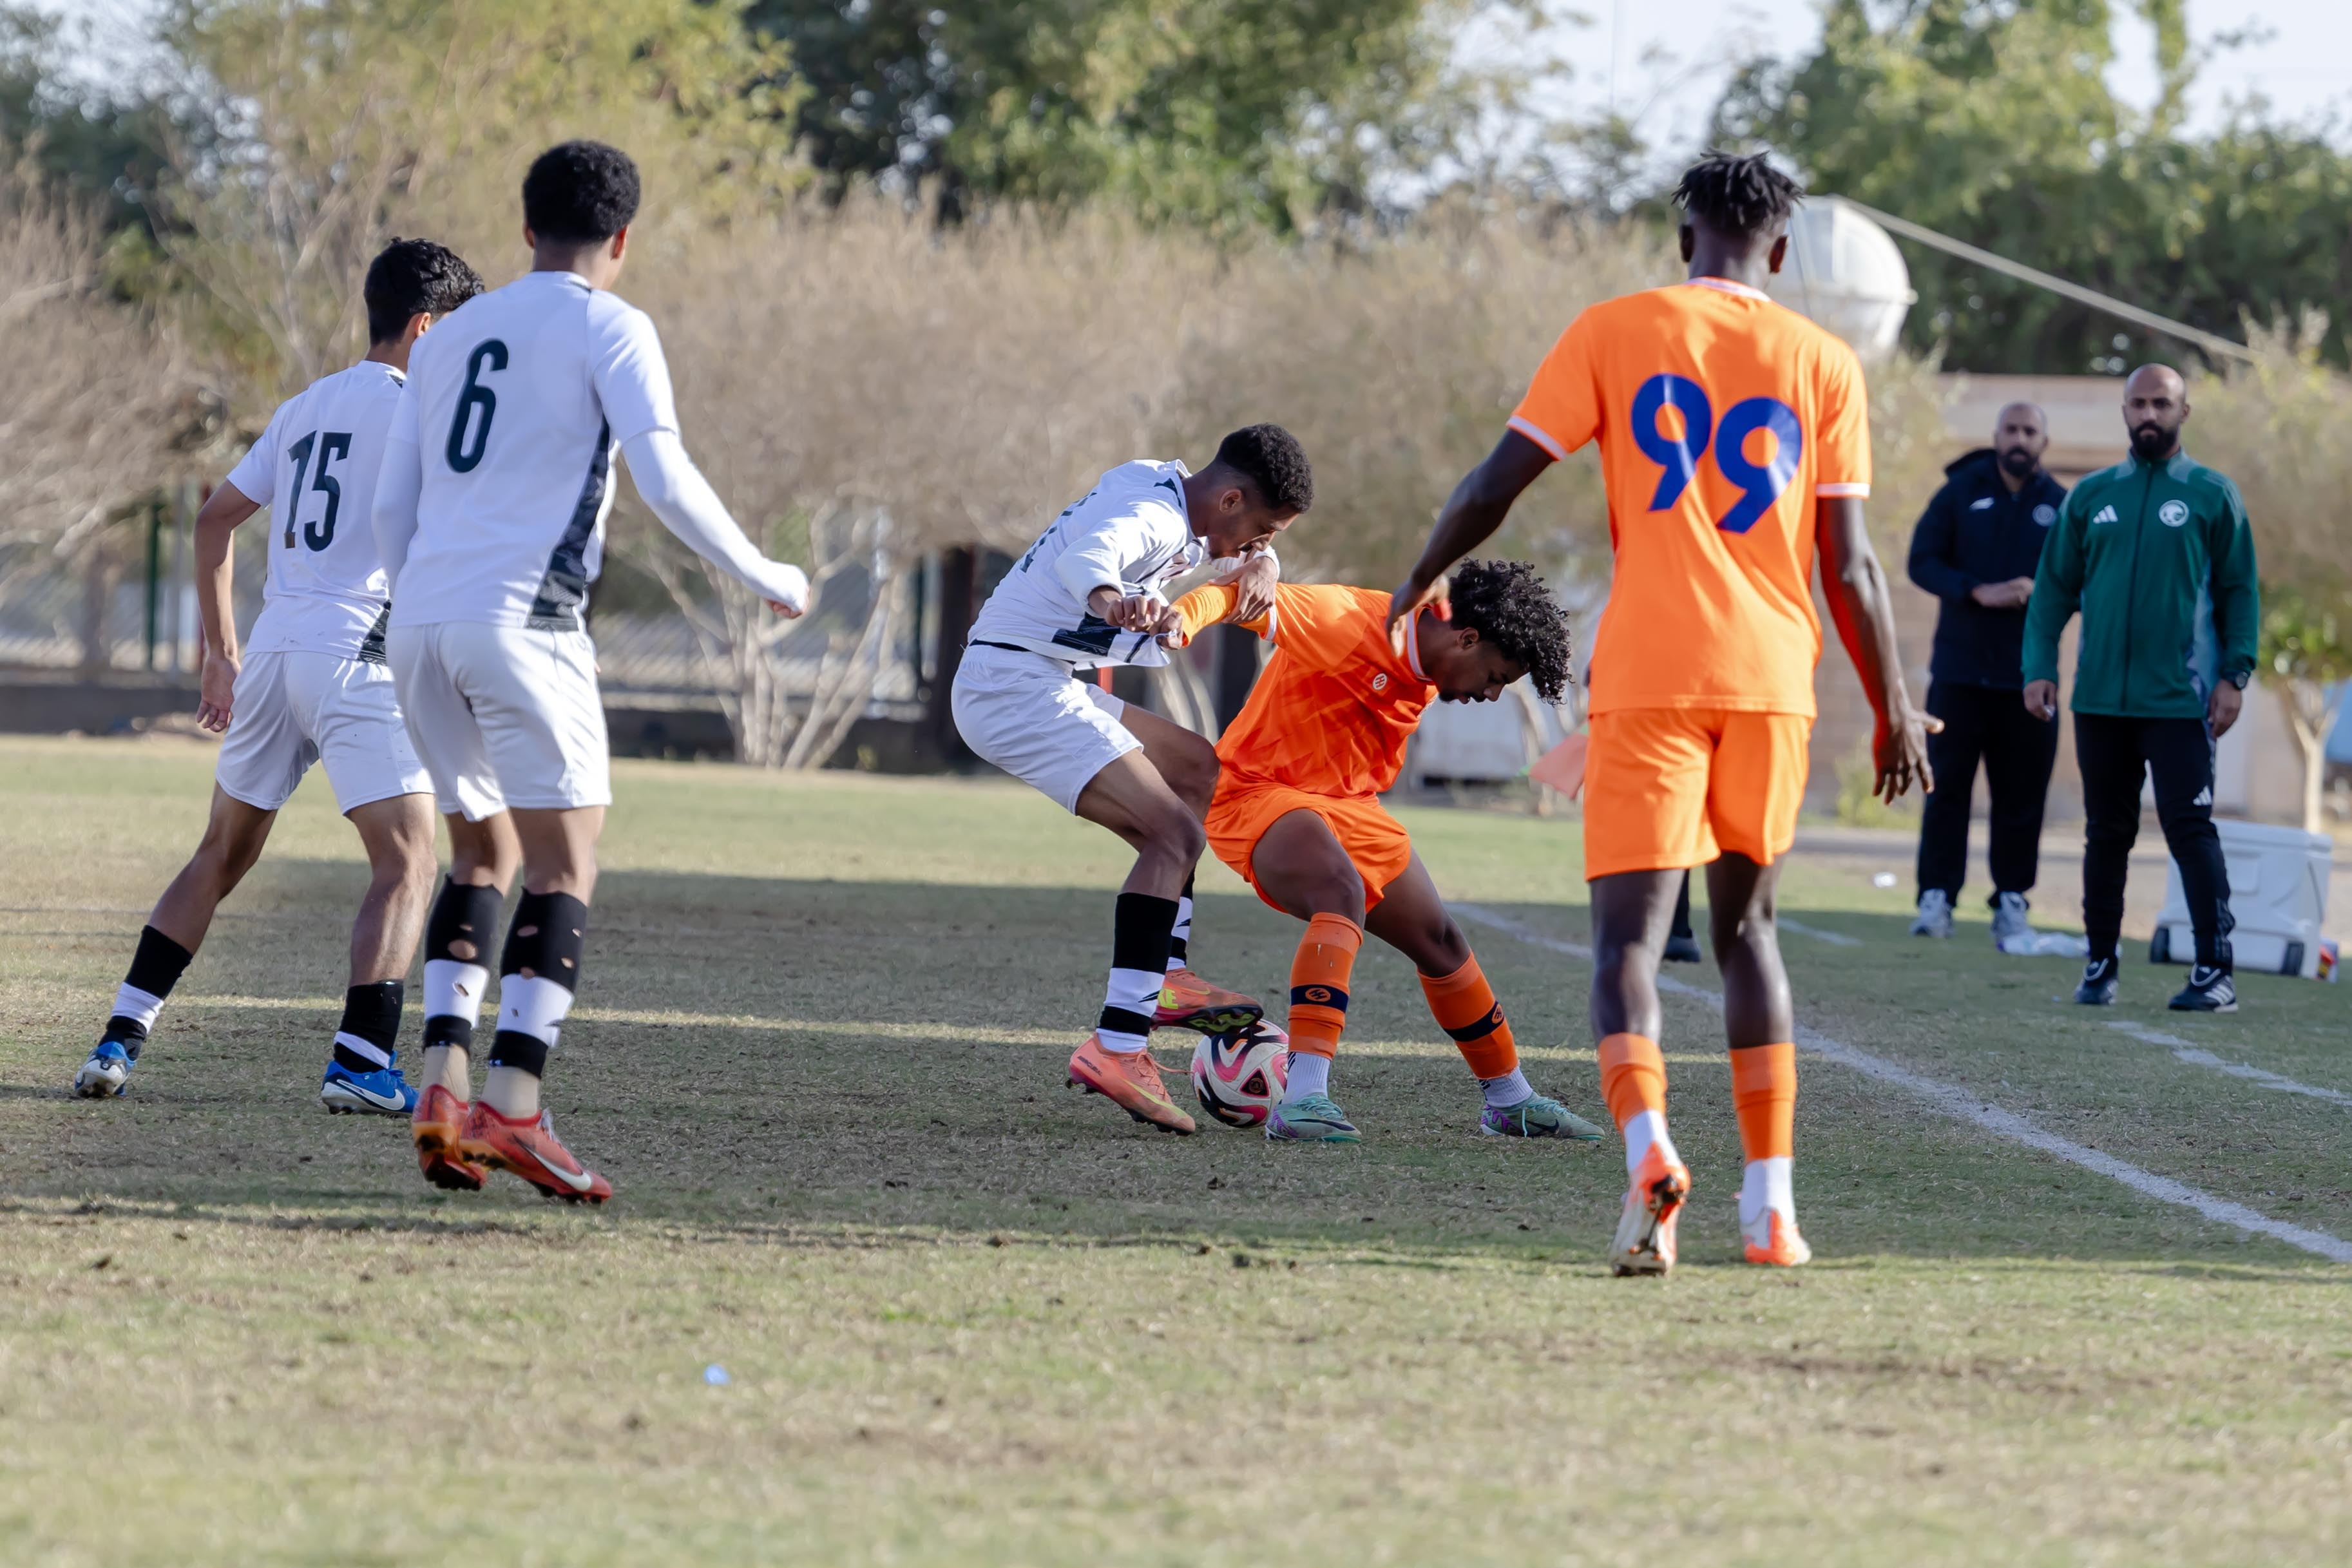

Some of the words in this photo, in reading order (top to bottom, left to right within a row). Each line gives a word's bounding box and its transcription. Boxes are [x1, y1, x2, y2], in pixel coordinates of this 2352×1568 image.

[445, 339, 509, 473] 6
[1631, 373, 1802, 534] 99
[284, 430, 352, 551] 15
